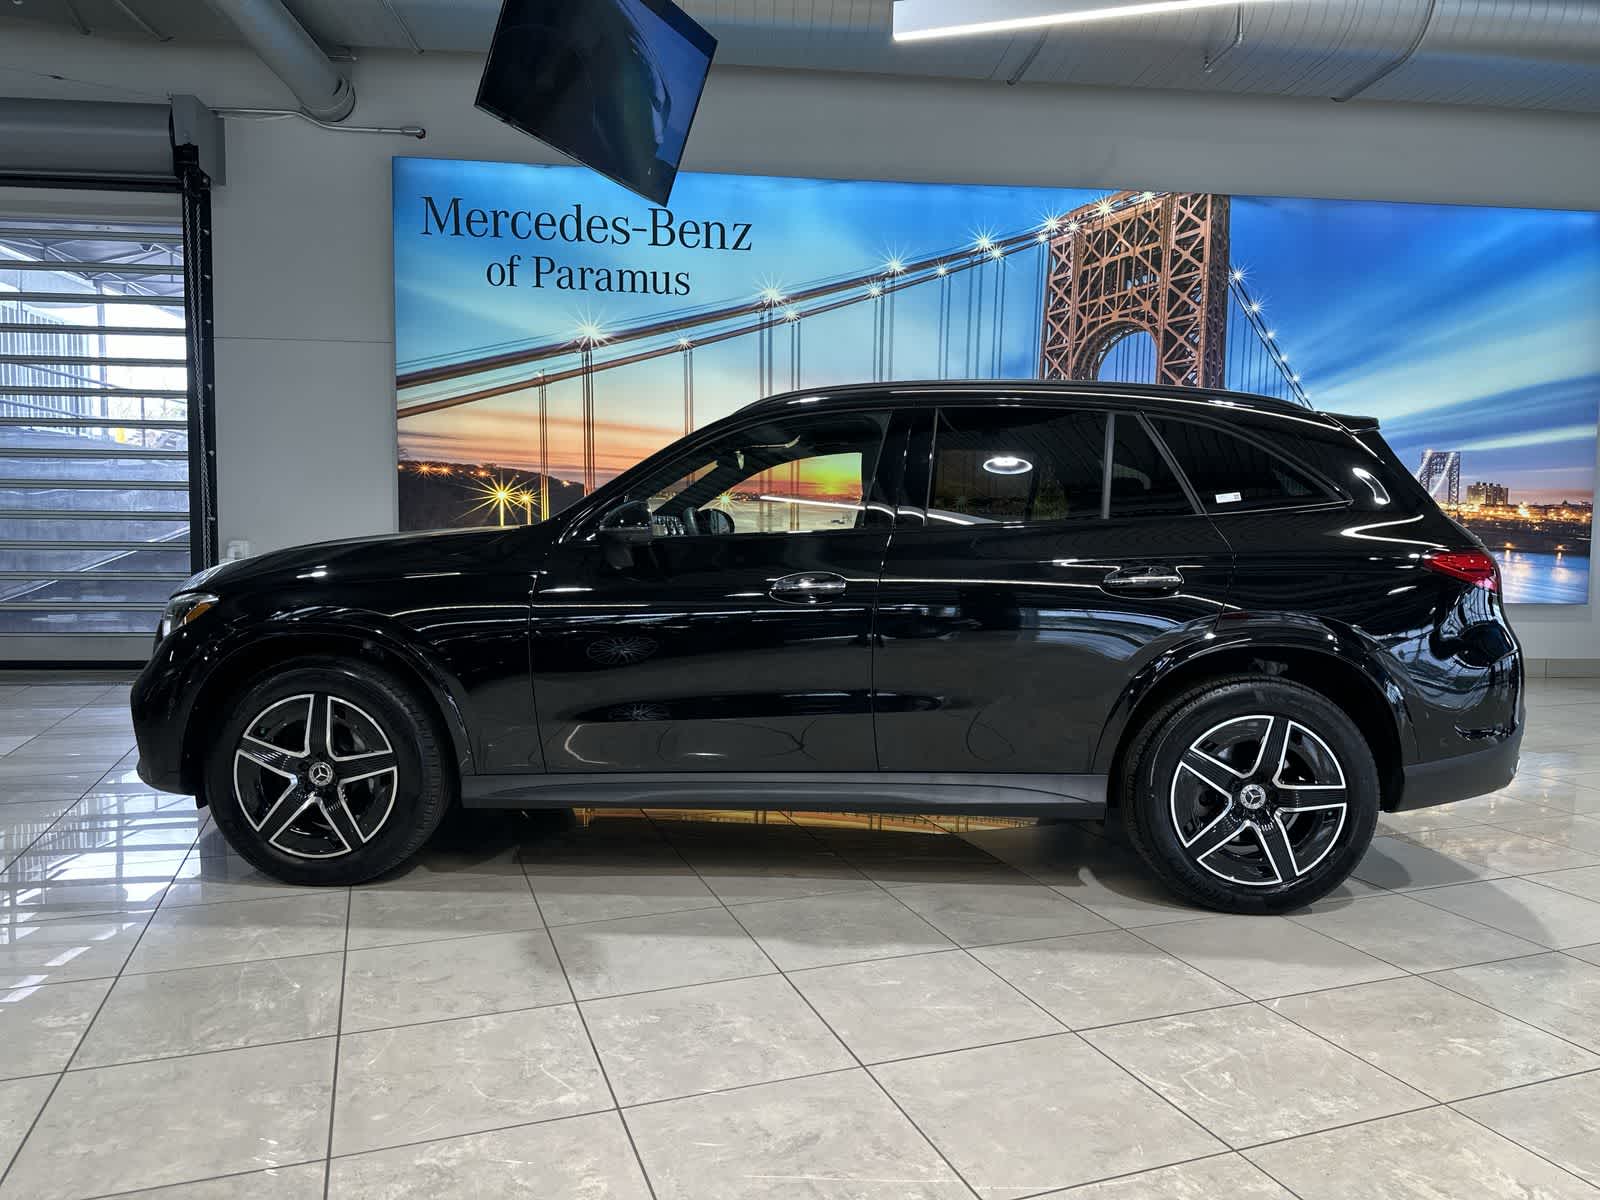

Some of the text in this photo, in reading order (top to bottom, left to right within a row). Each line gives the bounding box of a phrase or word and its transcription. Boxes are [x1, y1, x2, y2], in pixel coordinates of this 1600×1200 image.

[420, 196, 753, 251] Mercedes-Benz
[486, 254, 690, 296] of Paramus
